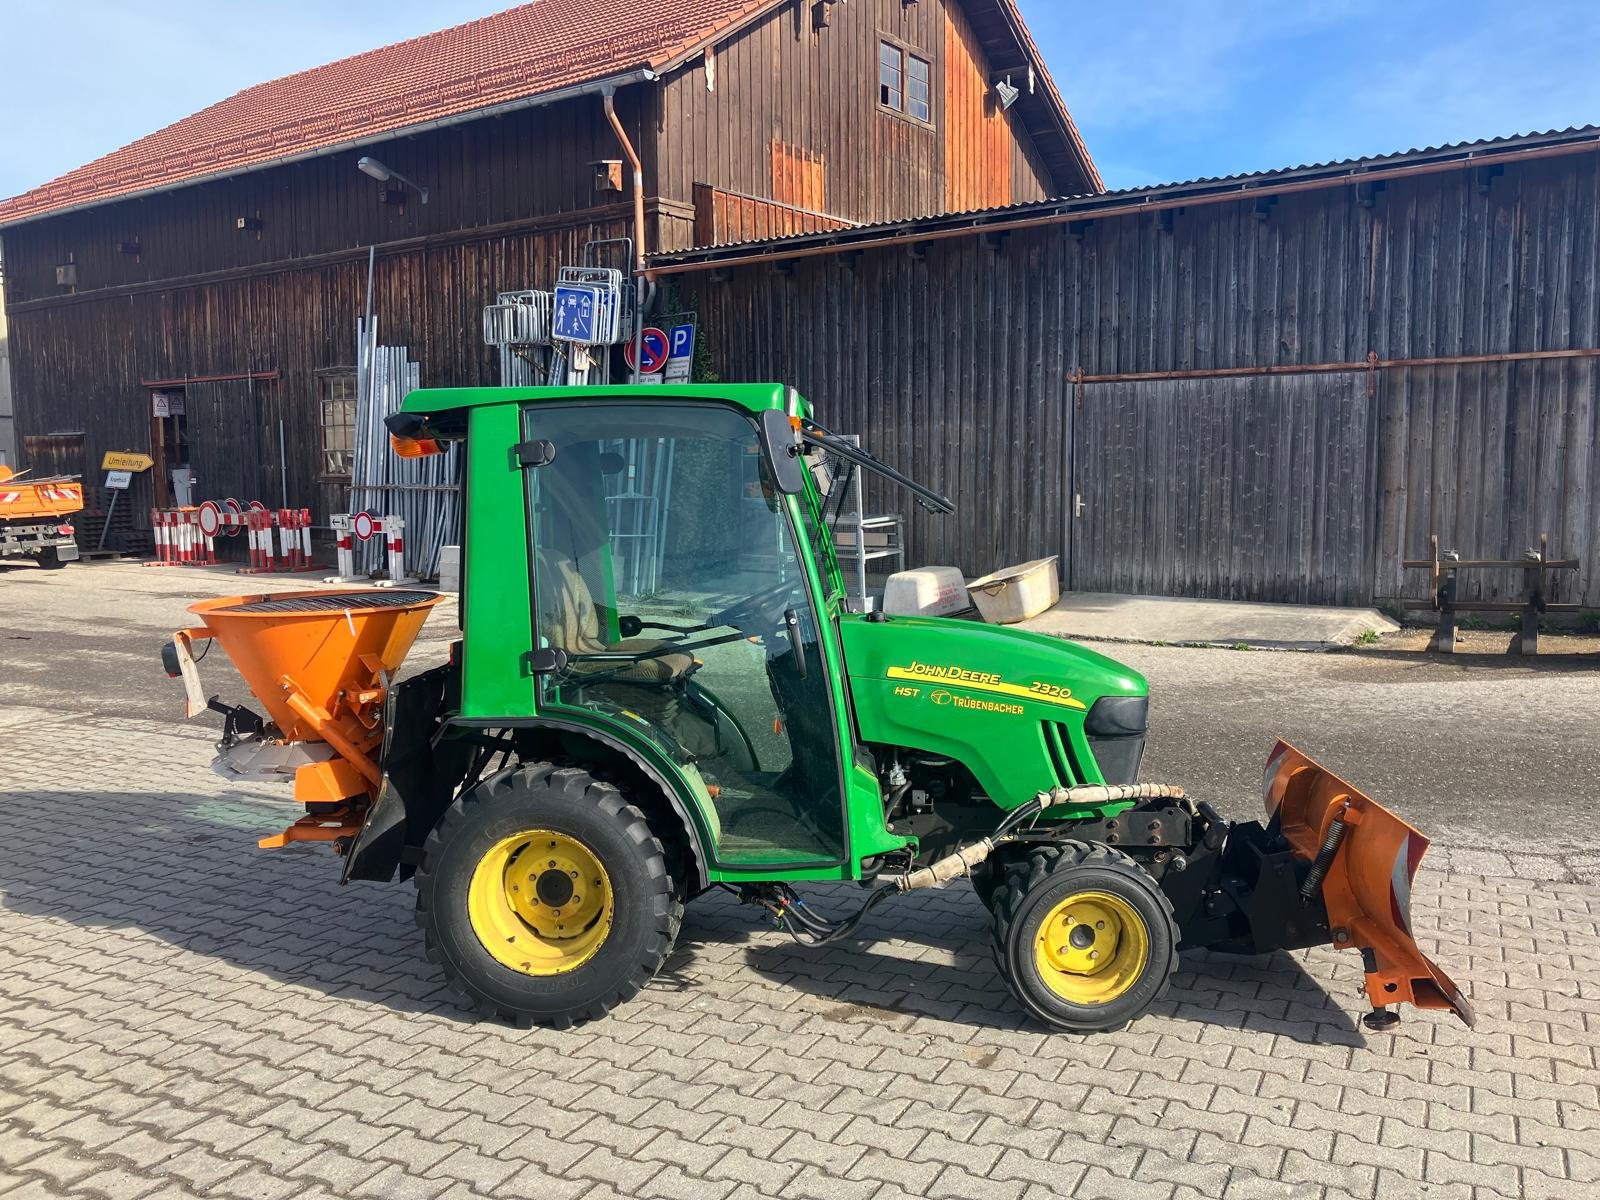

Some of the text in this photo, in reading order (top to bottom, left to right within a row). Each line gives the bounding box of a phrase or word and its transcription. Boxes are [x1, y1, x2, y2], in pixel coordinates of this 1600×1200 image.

[674, 330, 687, 355] P
[108, 456, 144, 469] Umleitung
[904, 661, 1001, 685] JOHN DEERE
[895, 686, 920, 697] HST
[1030, 682, 1072, 698] 2320
[953, 697, 1024, 715] TRÜBENBACHER
